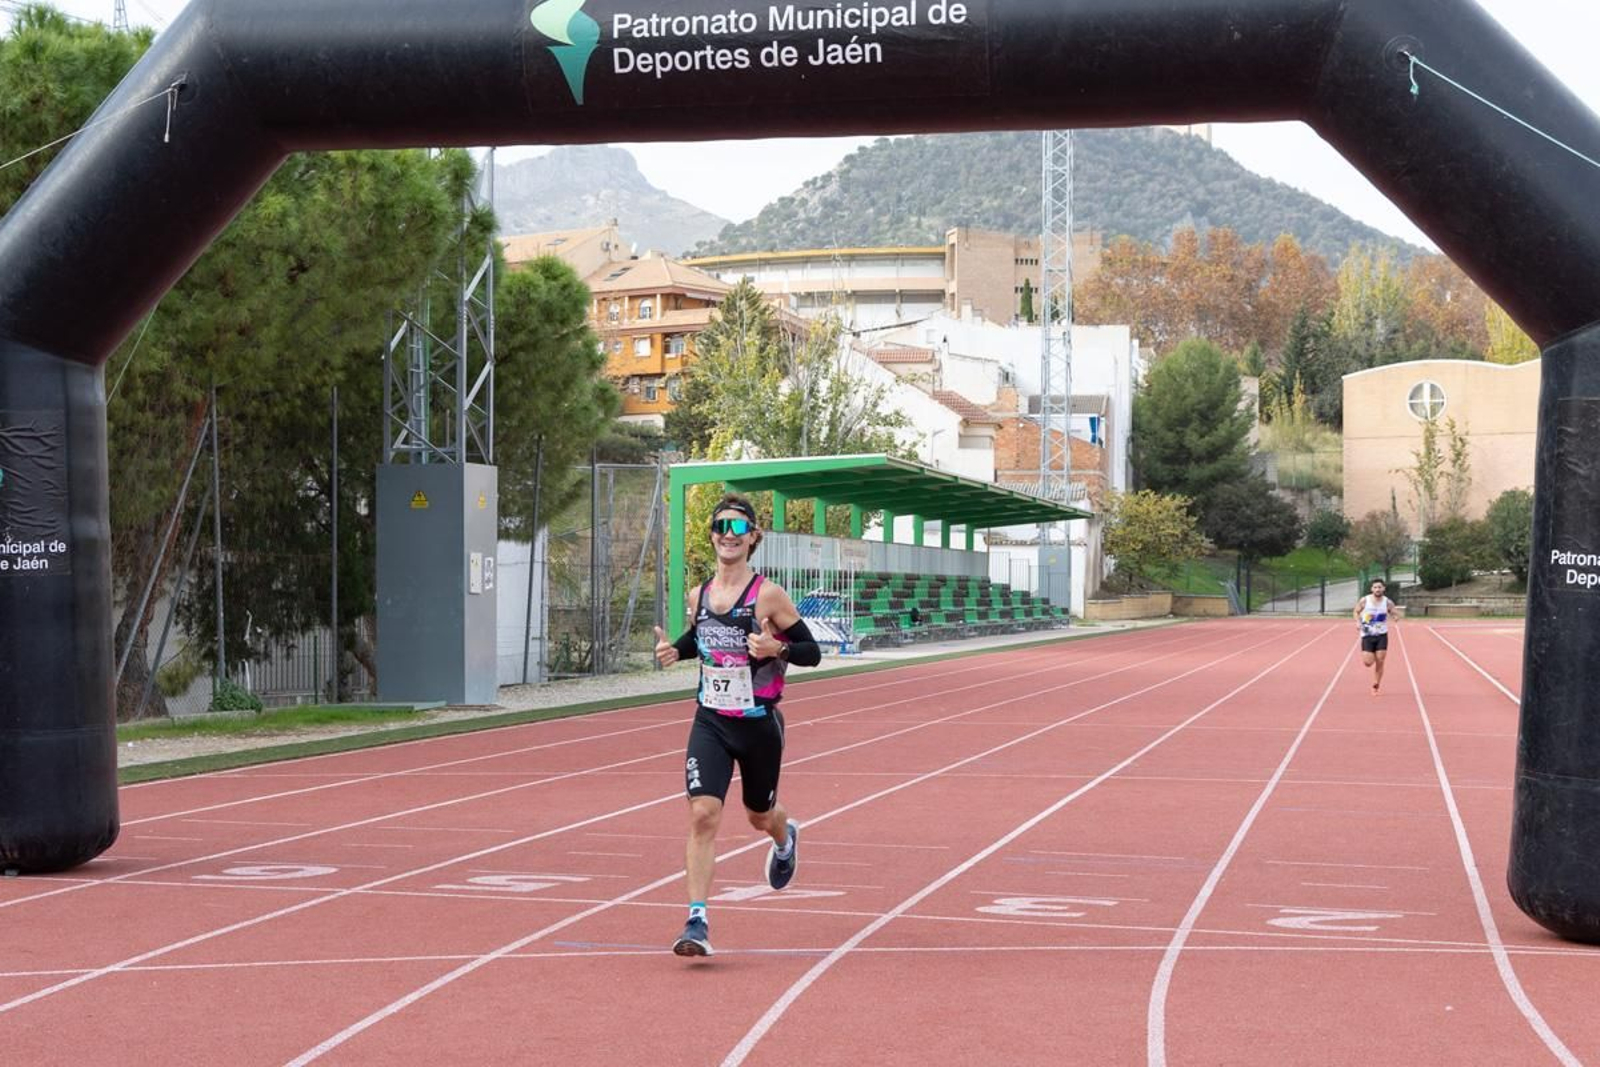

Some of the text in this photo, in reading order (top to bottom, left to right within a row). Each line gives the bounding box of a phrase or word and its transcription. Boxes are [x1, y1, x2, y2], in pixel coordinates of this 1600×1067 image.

[612, 0, 967, 39] Patronato Municipal de
[613, 35, 882, 79] Deportes de Jaén
[49, 540, 66, 553] de
[13, 556, 49, 570] Jaén
[1566, 569, 1600, 589] Dep
[712, 679, 731, 692] 67
